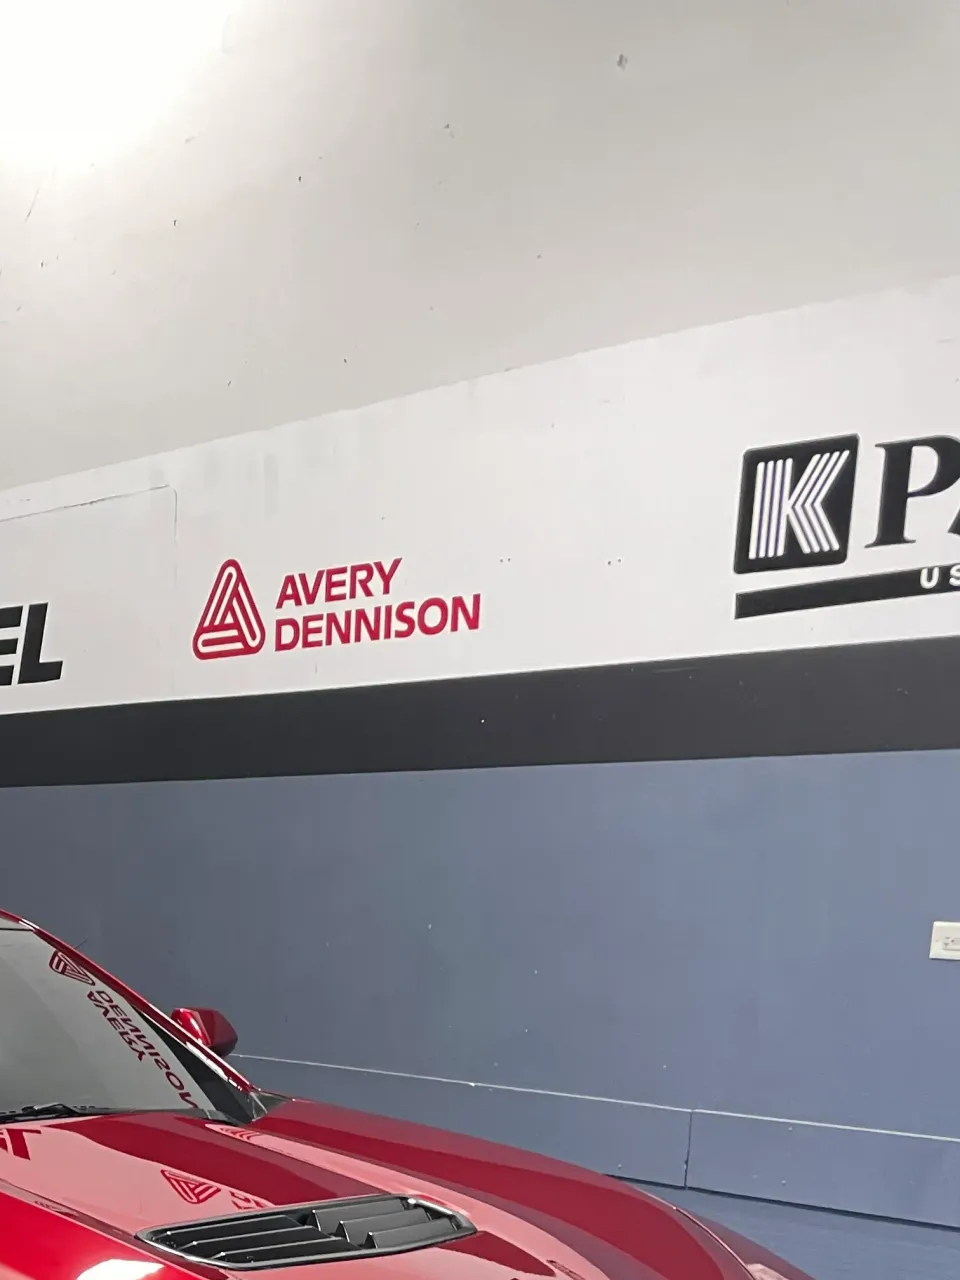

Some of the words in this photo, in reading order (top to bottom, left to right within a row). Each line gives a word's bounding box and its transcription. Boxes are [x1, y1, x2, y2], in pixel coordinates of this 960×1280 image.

[864, 434, 960, 549] P
[275, 557, 403, 609] AVERY
[274, 593, 481, 652] DENNISON
